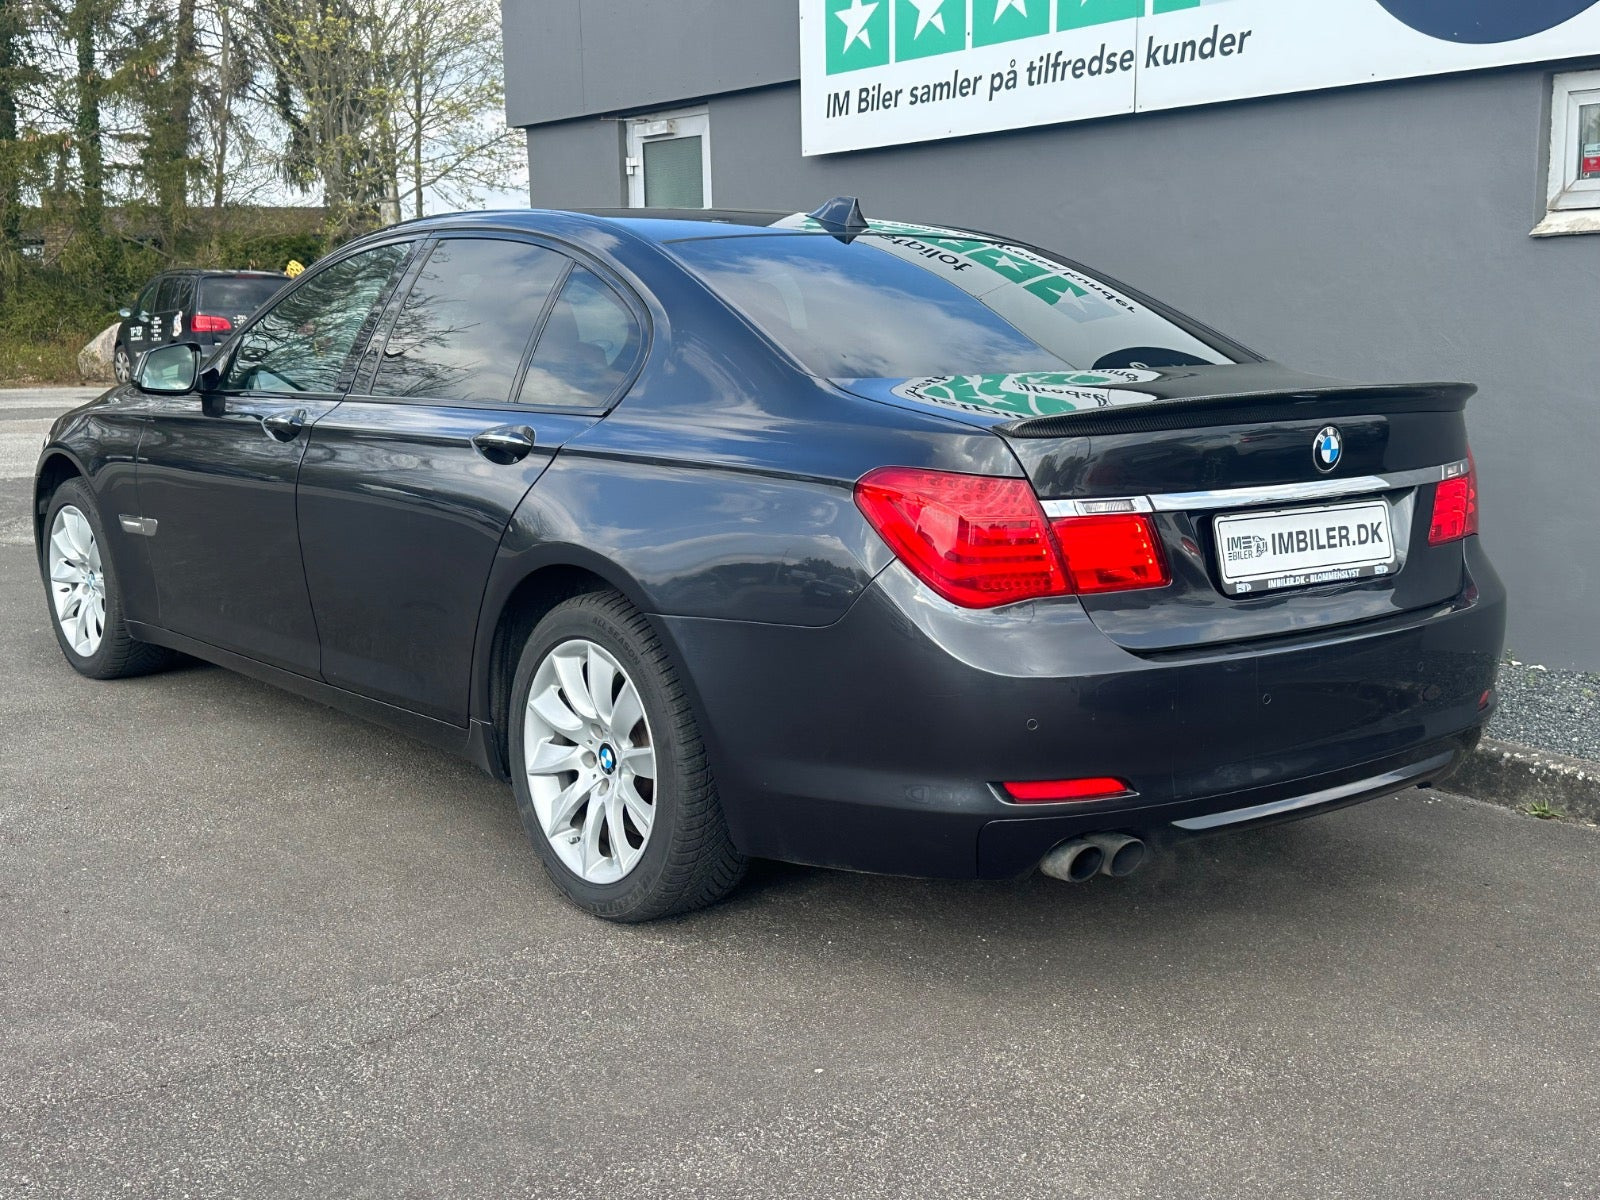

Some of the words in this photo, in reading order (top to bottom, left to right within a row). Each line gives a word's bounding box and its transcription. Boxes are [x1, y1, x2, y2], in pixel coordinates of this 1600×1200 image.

[826, 91, 849, 118] IM
[857, 83, 903, 113] Biler
[908, 70, 982, 106] samler
[988, 59, 1018, 101] på
[1026, 44, 1134, 87] tilfredse
[1144, 24, 1252, 69] kunder
[1271, 521, 1383, 556] IMBILER.DK
[1267, 575, 1305, 589] IMBILER.DK
[607, 626, 640, 666] SEASON
